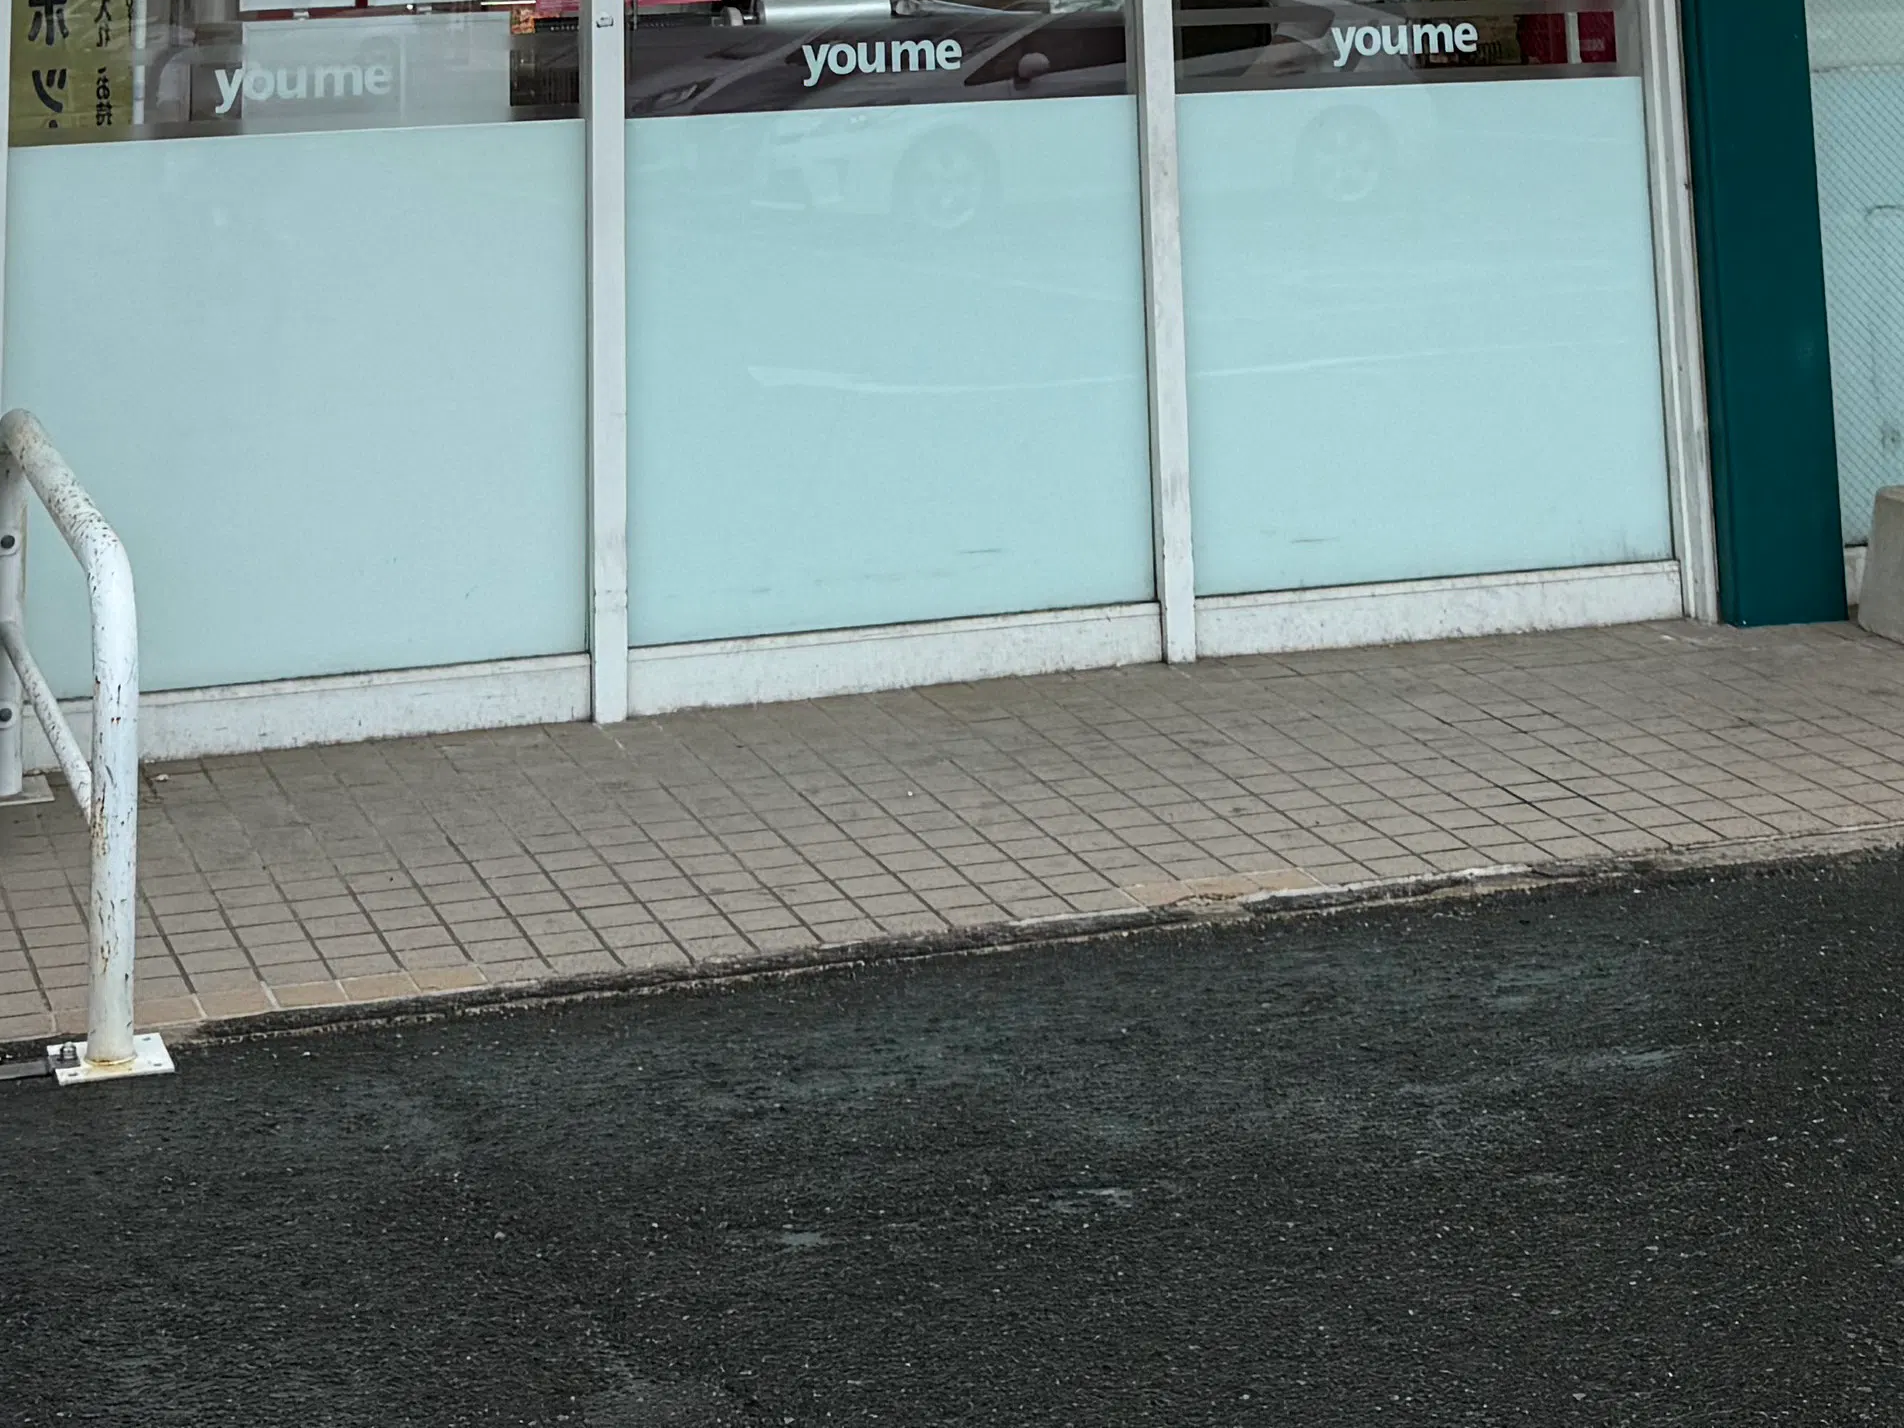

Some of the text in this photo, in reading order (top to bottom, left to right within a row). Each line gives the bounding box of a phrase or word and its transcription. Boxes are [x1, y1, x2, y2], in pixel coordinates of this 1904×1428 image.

[802, 38, 963, 87] youme
[1332, 19, 1479, 68] youme
[215, 54, 393, 114] youme
